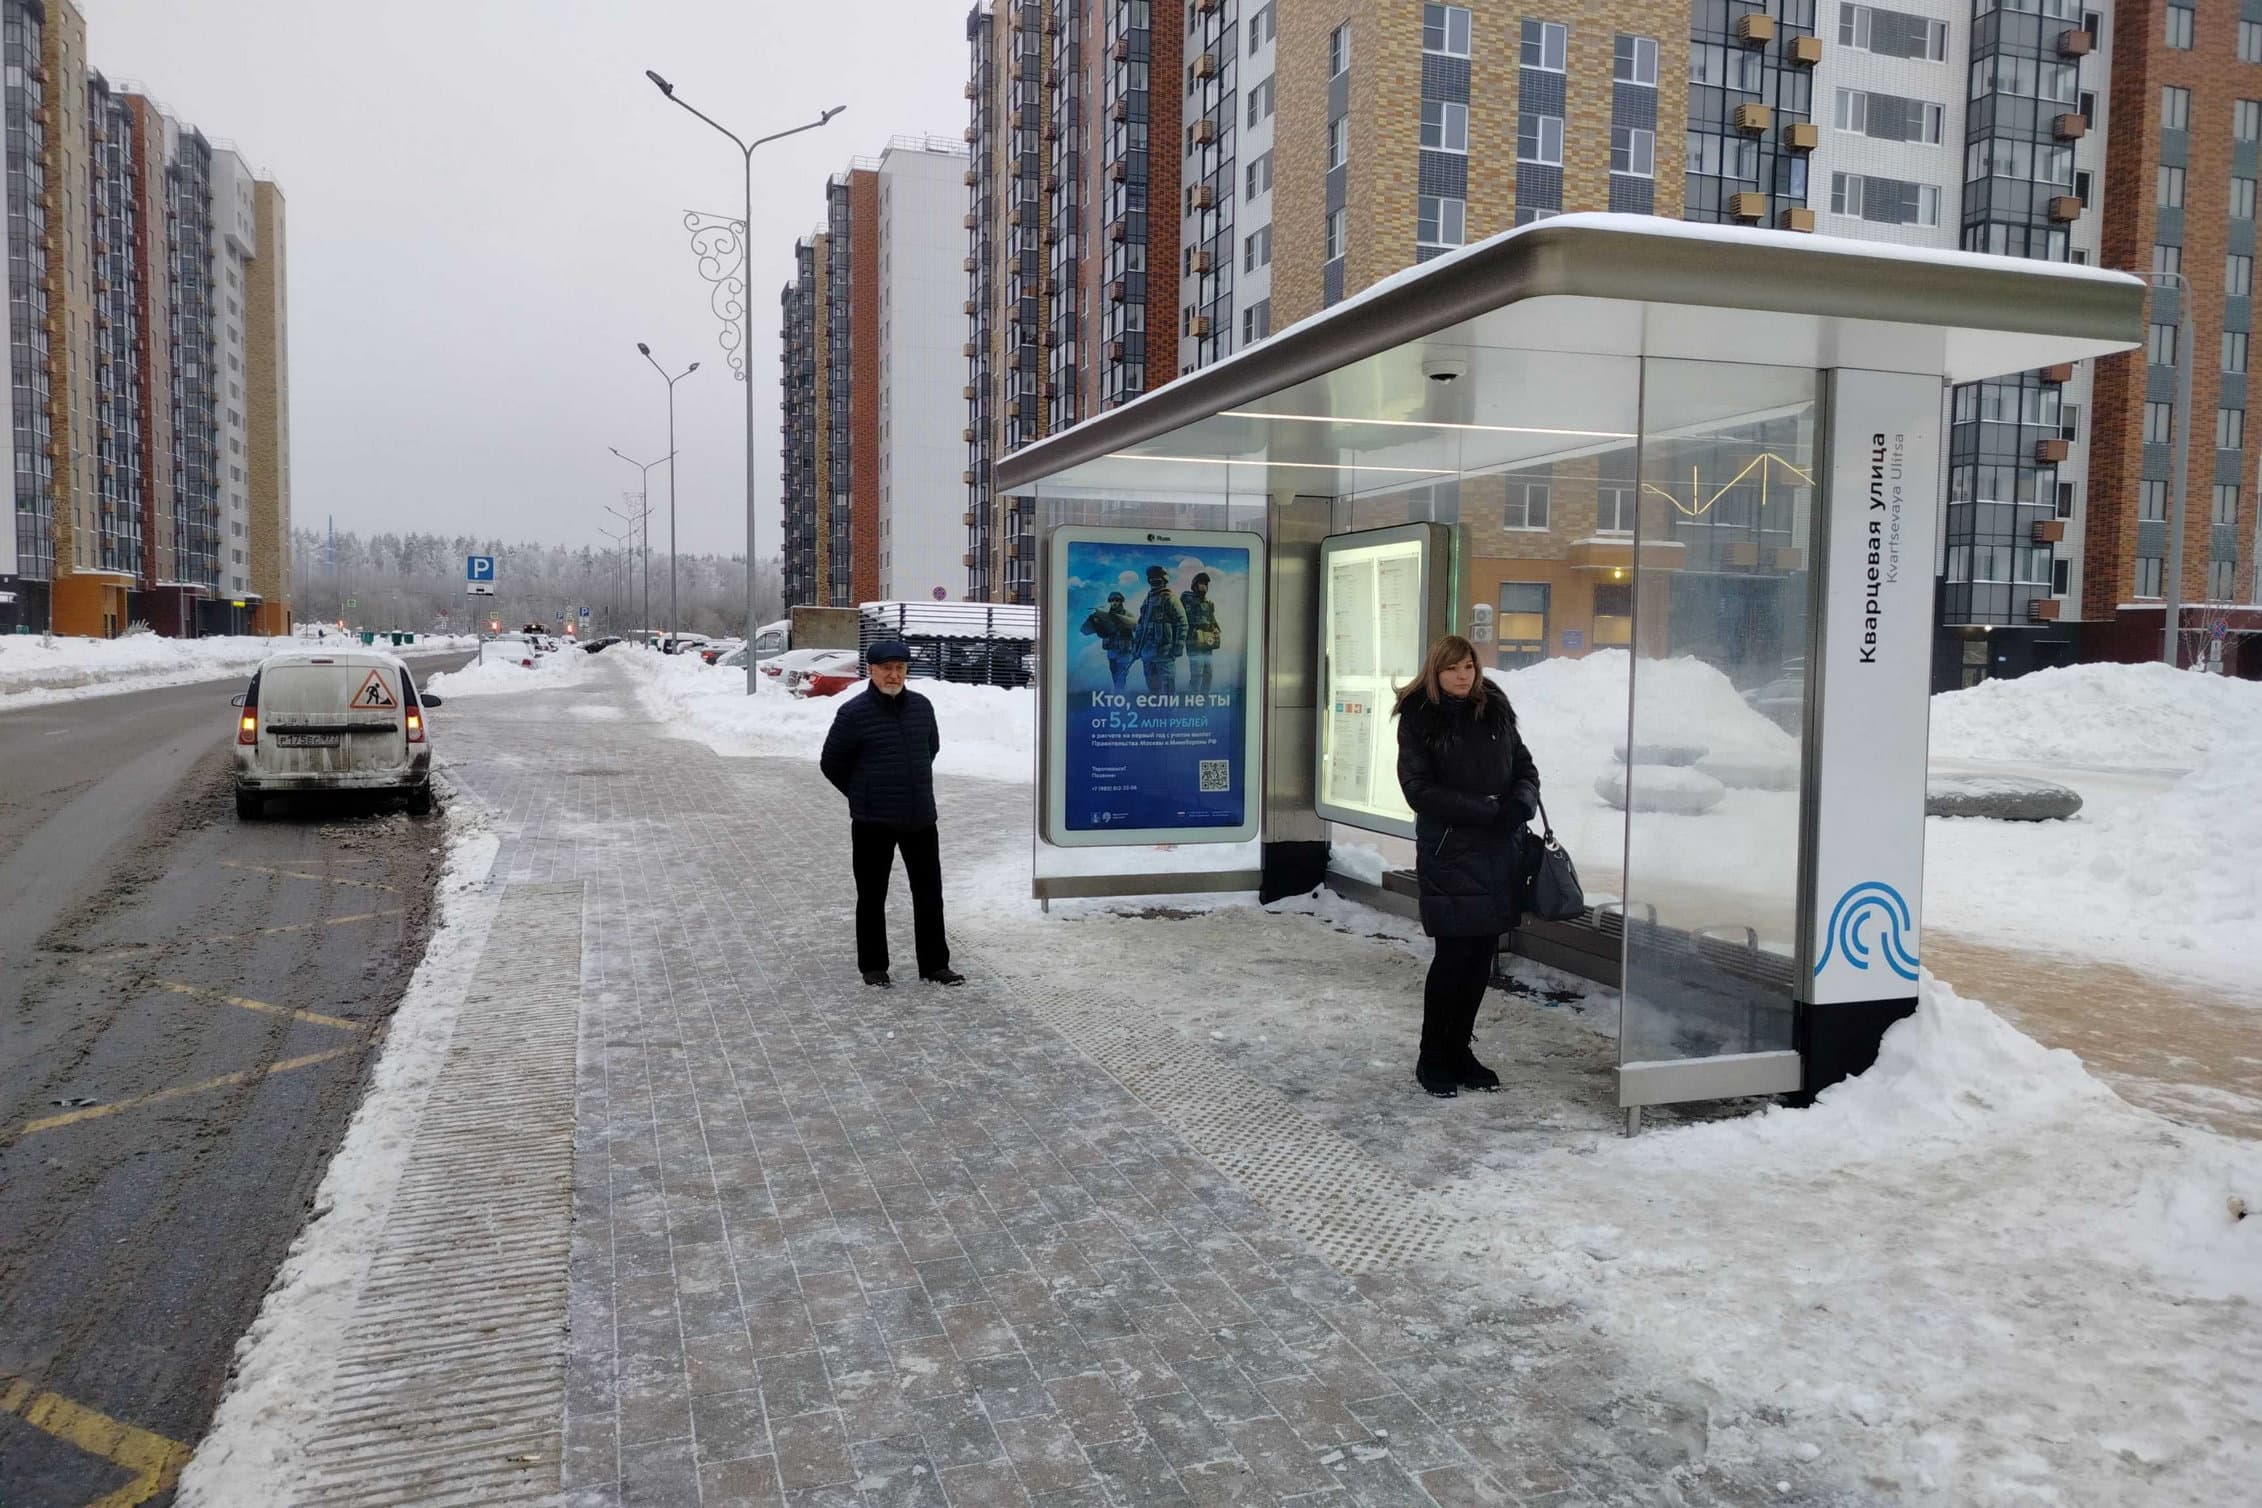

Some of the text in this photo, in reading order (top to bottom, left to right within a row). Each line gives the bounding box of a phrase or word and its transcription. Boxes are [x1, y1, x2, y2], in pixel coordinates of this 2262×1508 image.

[1886, 433, 1904, 583] Kvartsevaya Ulitsa
[1859, 432, 1887, 663] Кварцевая улица
[474, 558, 489, 579] P
[1092, 690, 1231, 711] Кто, если не ты
[1109, 711, 1138, 731] 5,2
[1169, 715, 1208, 728] РУБЛЕЙ
